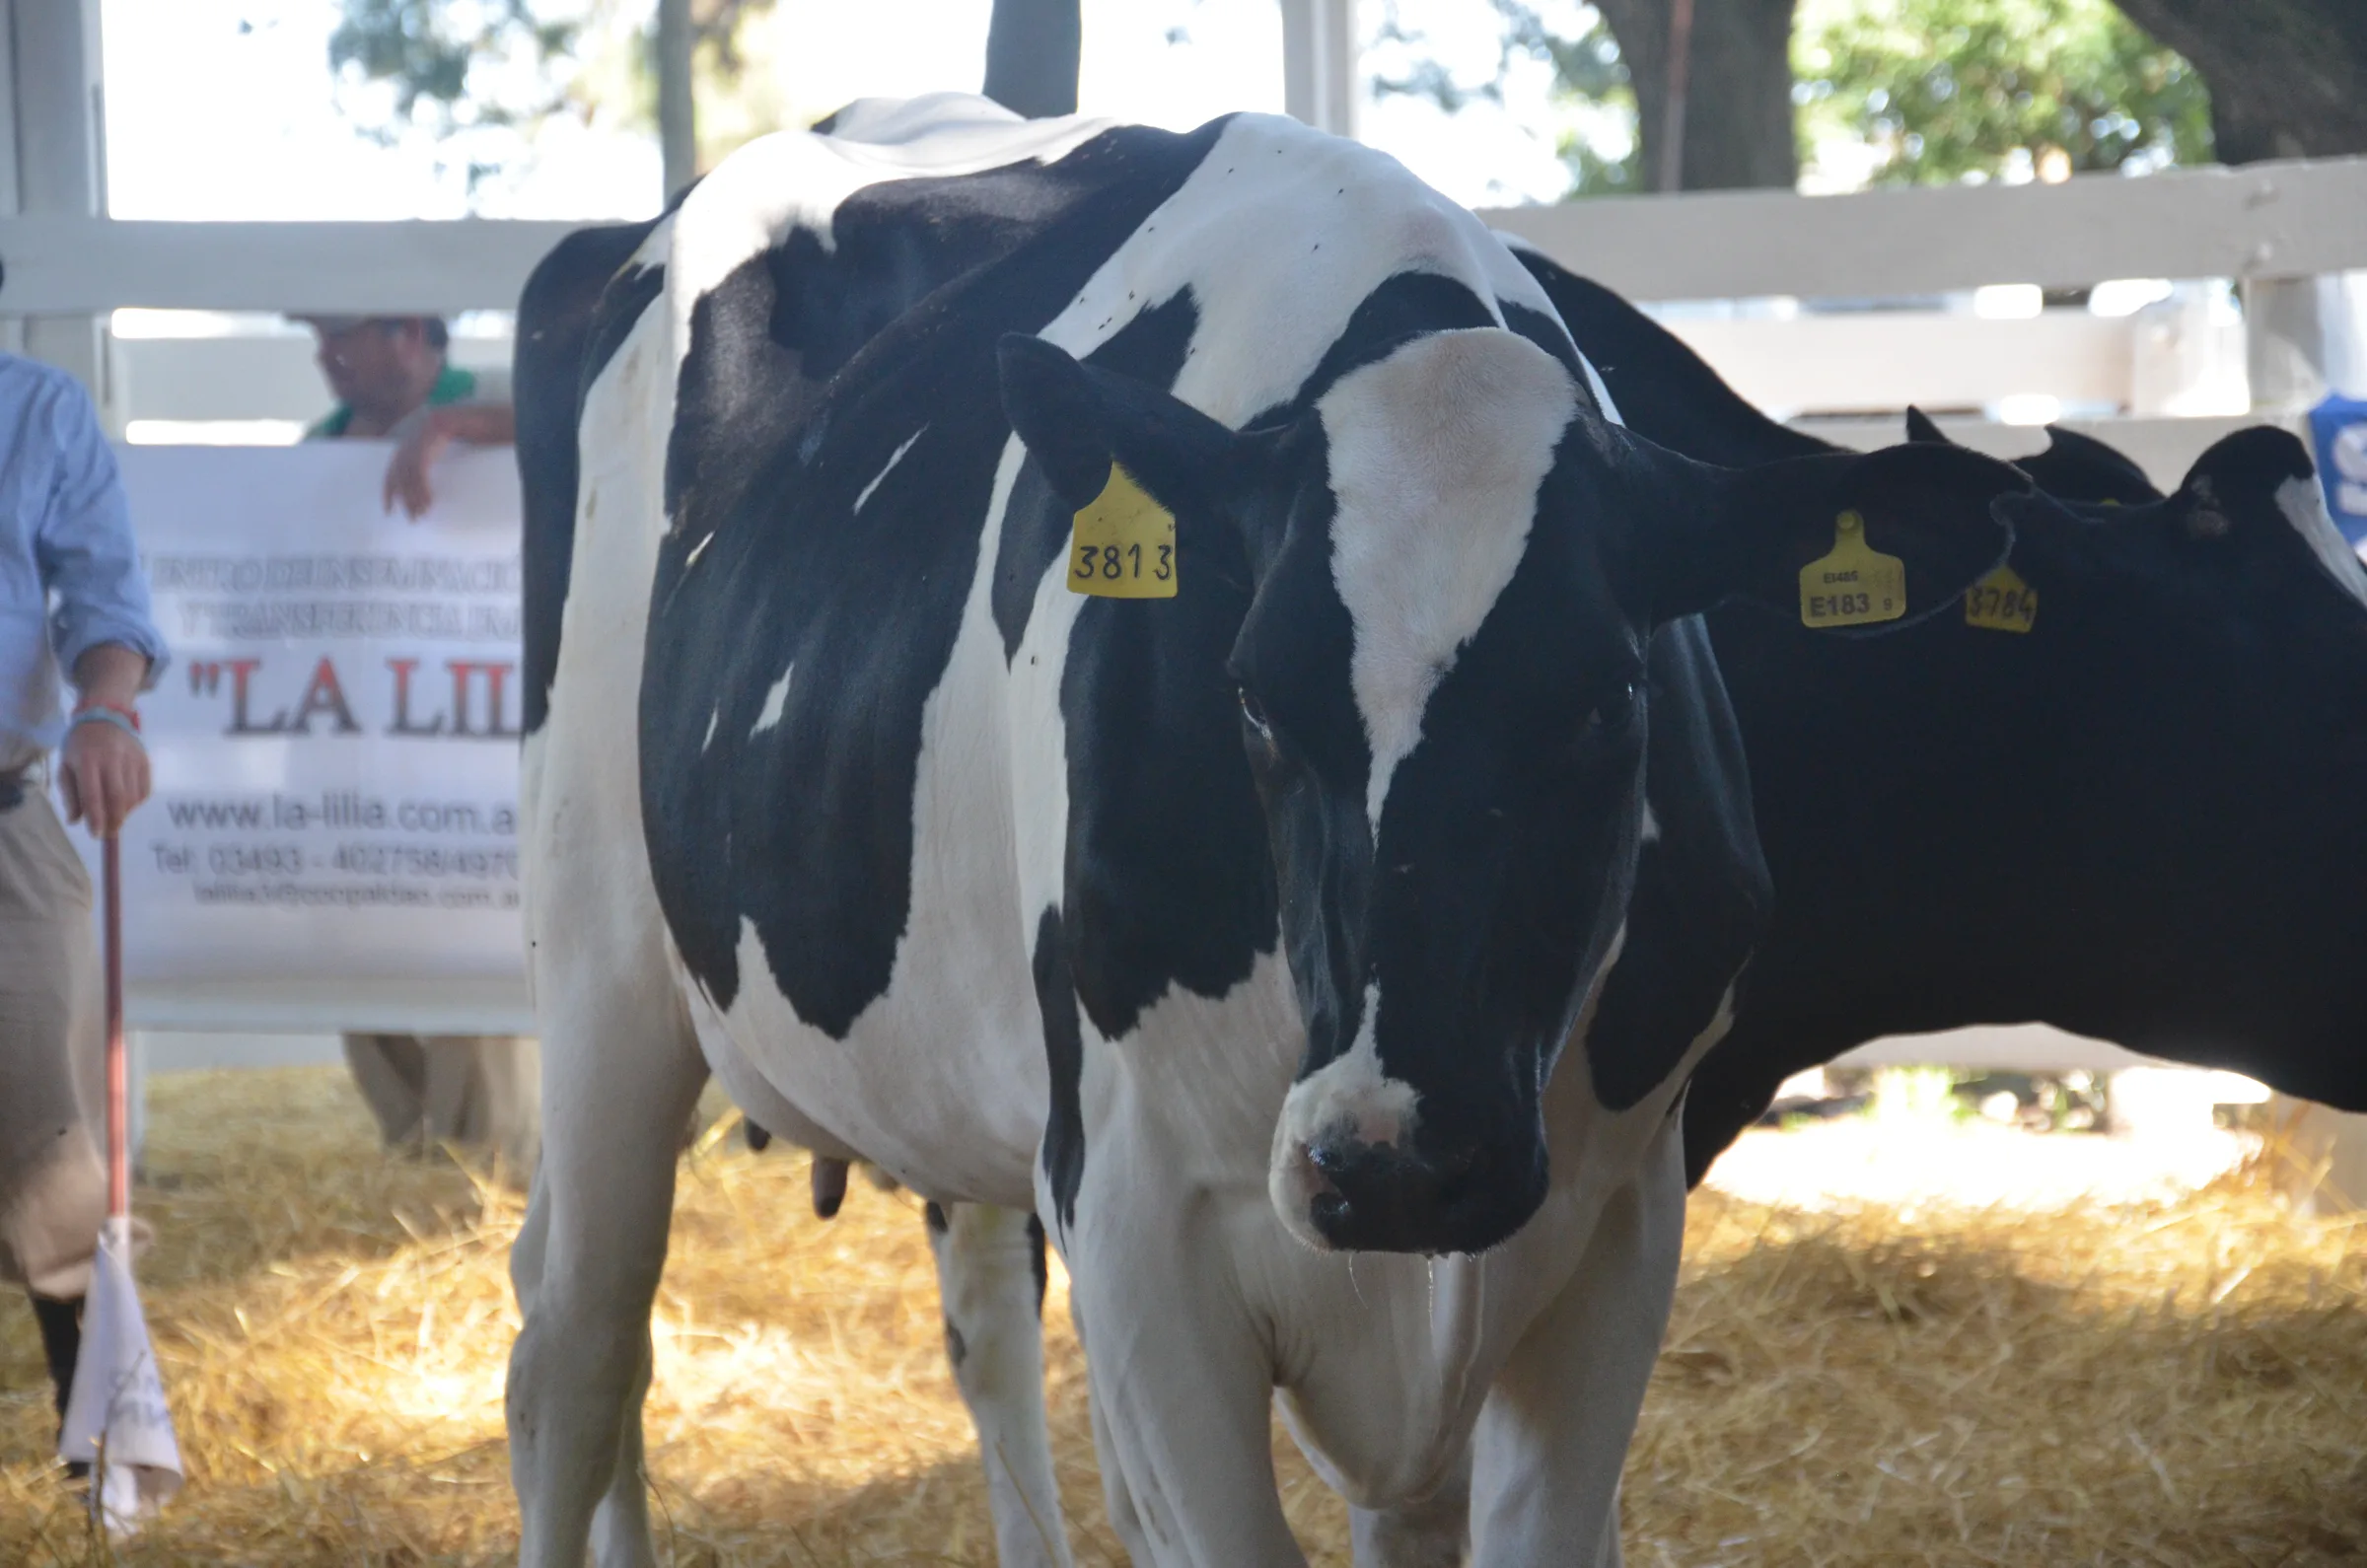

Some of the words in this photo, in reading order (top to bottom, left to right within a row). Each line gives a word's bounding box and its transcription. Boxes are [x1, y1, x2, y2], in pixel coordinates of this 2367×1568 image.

[138, 555, 263, 594] ENTRO
[1073, 542, 1173, 581] 3813
[1810, 592, 1871, 618] E183
[1969, 585, 2036, 622] 3784
[189, 657, 362, 736] "LA
